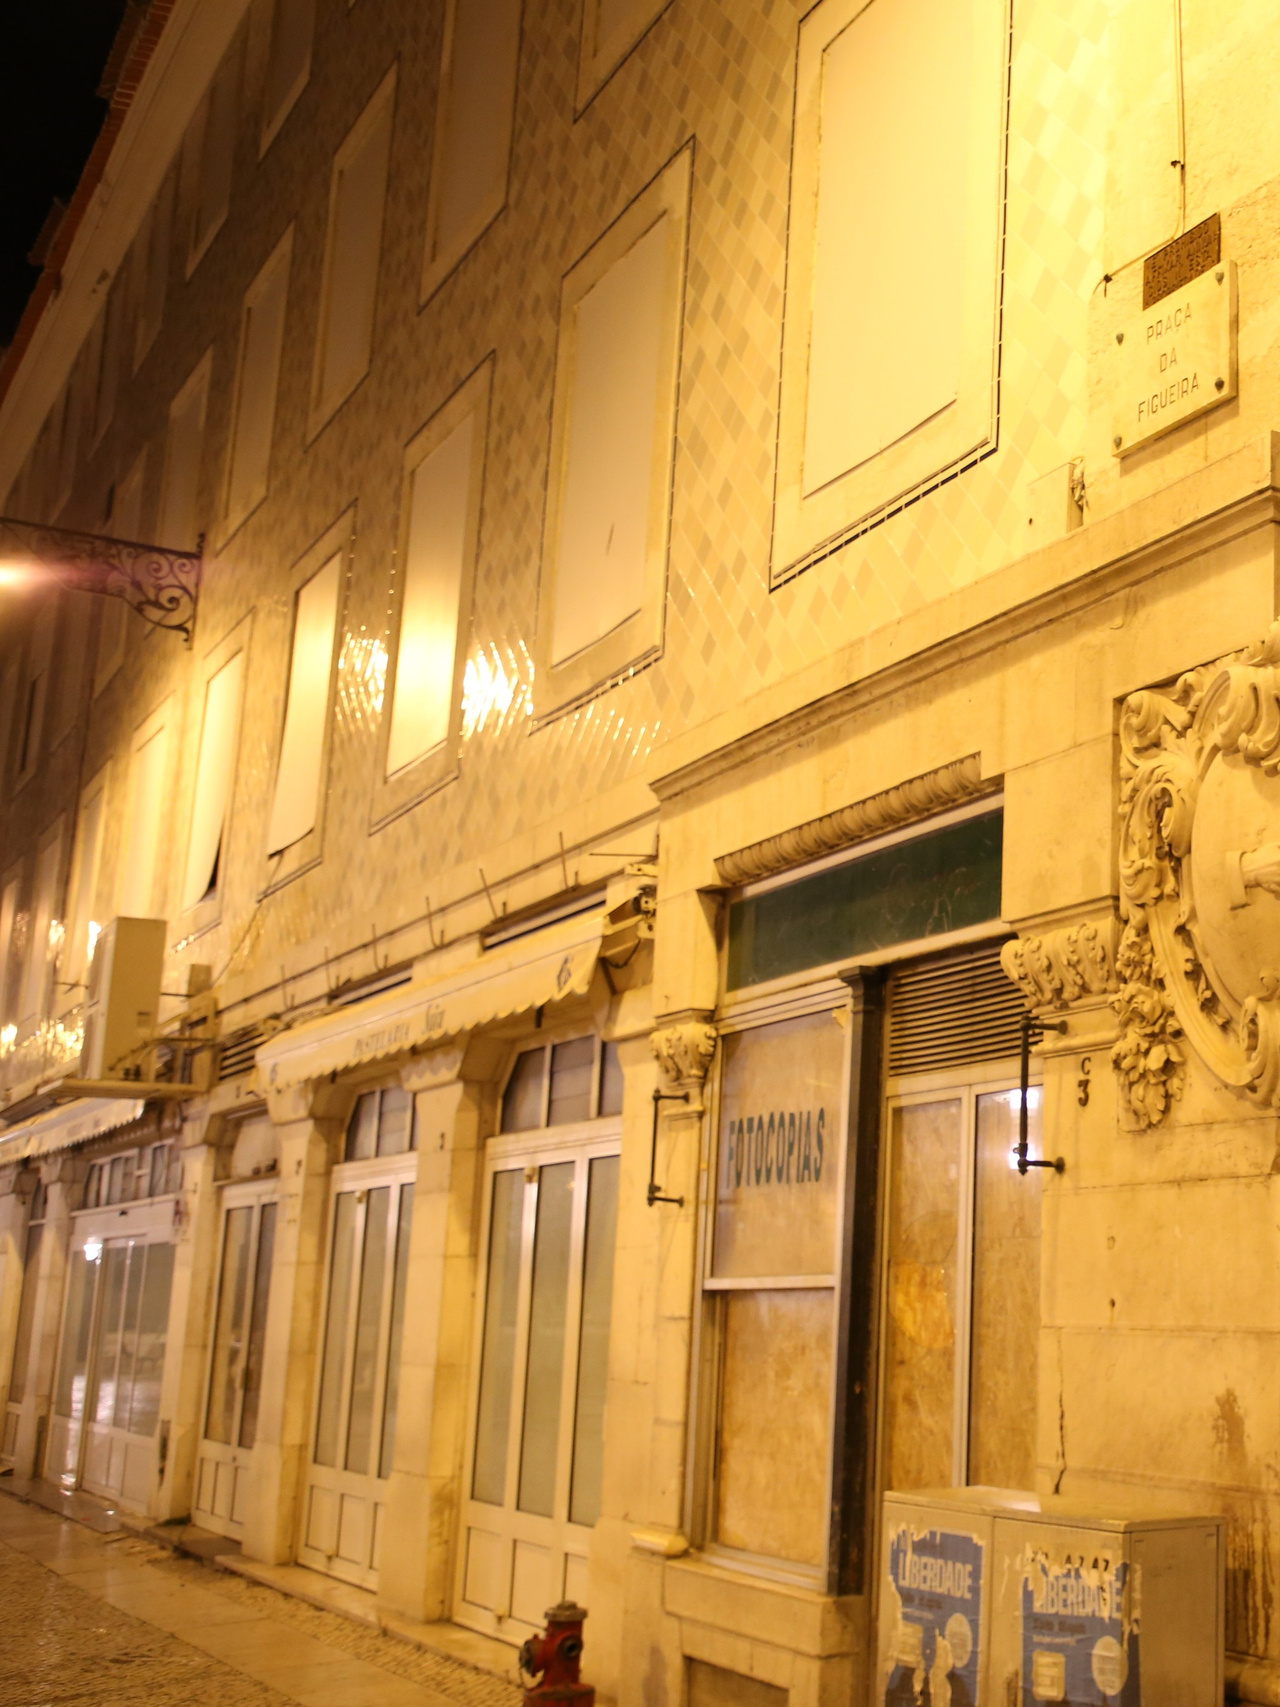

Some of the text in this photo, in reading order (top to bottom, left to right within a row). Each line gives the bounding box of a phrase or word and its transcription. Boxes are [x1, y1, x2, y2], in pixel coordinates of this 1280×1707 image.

[1146, 302, 1193, 346] PRAÇA
[1159, 347, 1178, 374] DA
[1137, 372, 1200, 423] FIGUEIRA
[1077, 1078, 1090, 1107] 3
[726, 1107, 825, 1189] FOTOCOPIAS
[898, 1552, 973, 1600] LIBERDADE
